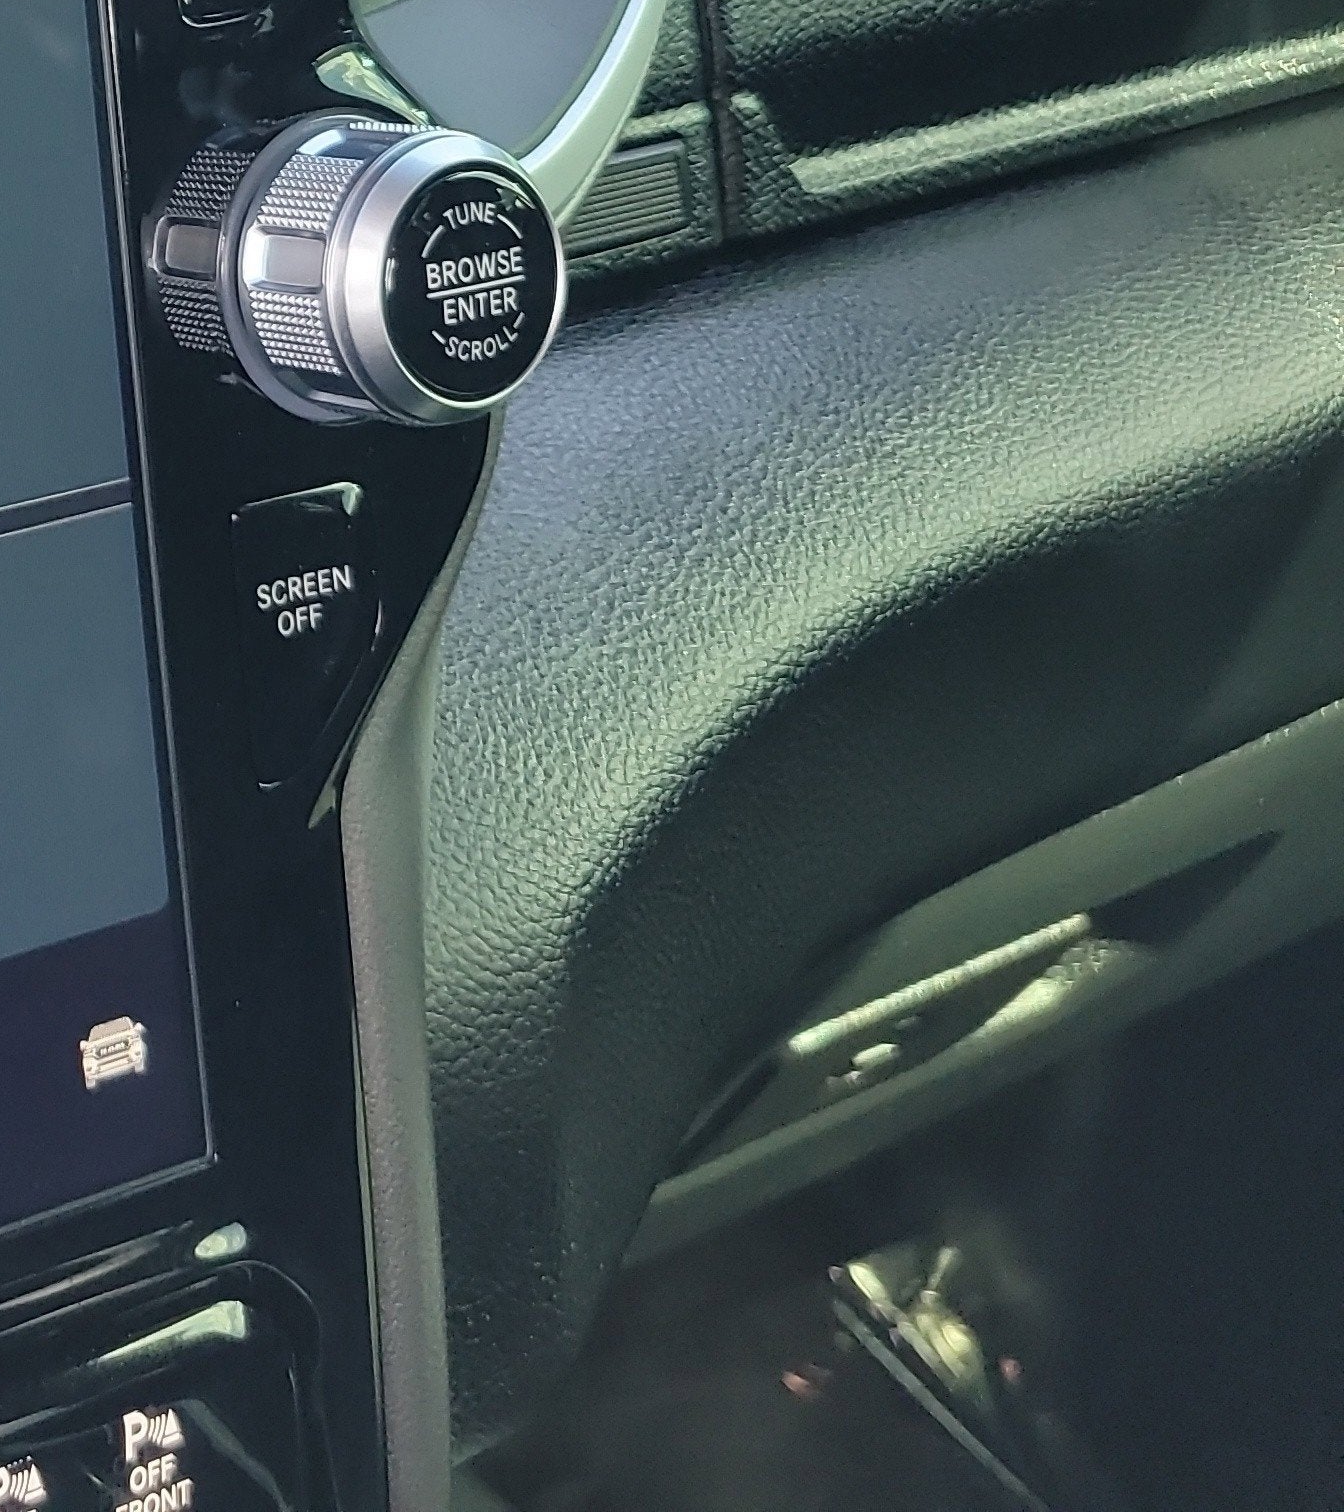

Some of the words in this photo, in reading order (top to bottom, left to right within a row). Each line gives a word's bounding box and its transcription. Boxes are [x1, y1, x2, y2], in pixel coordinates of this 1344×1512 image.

[444, 201, 496, 226] TUNE
[426, 248, 524, 290] BROWSE
[442, 287, 518, 325] ENTER
[444, 329, 519, 362] SCROLL
[256, 565, 352, 609] SCREEN
[277, 604, 324, 638] OFF
[129, 1453, 178, 1494] OFF
[115, 1478, 195, 1512] ONT
